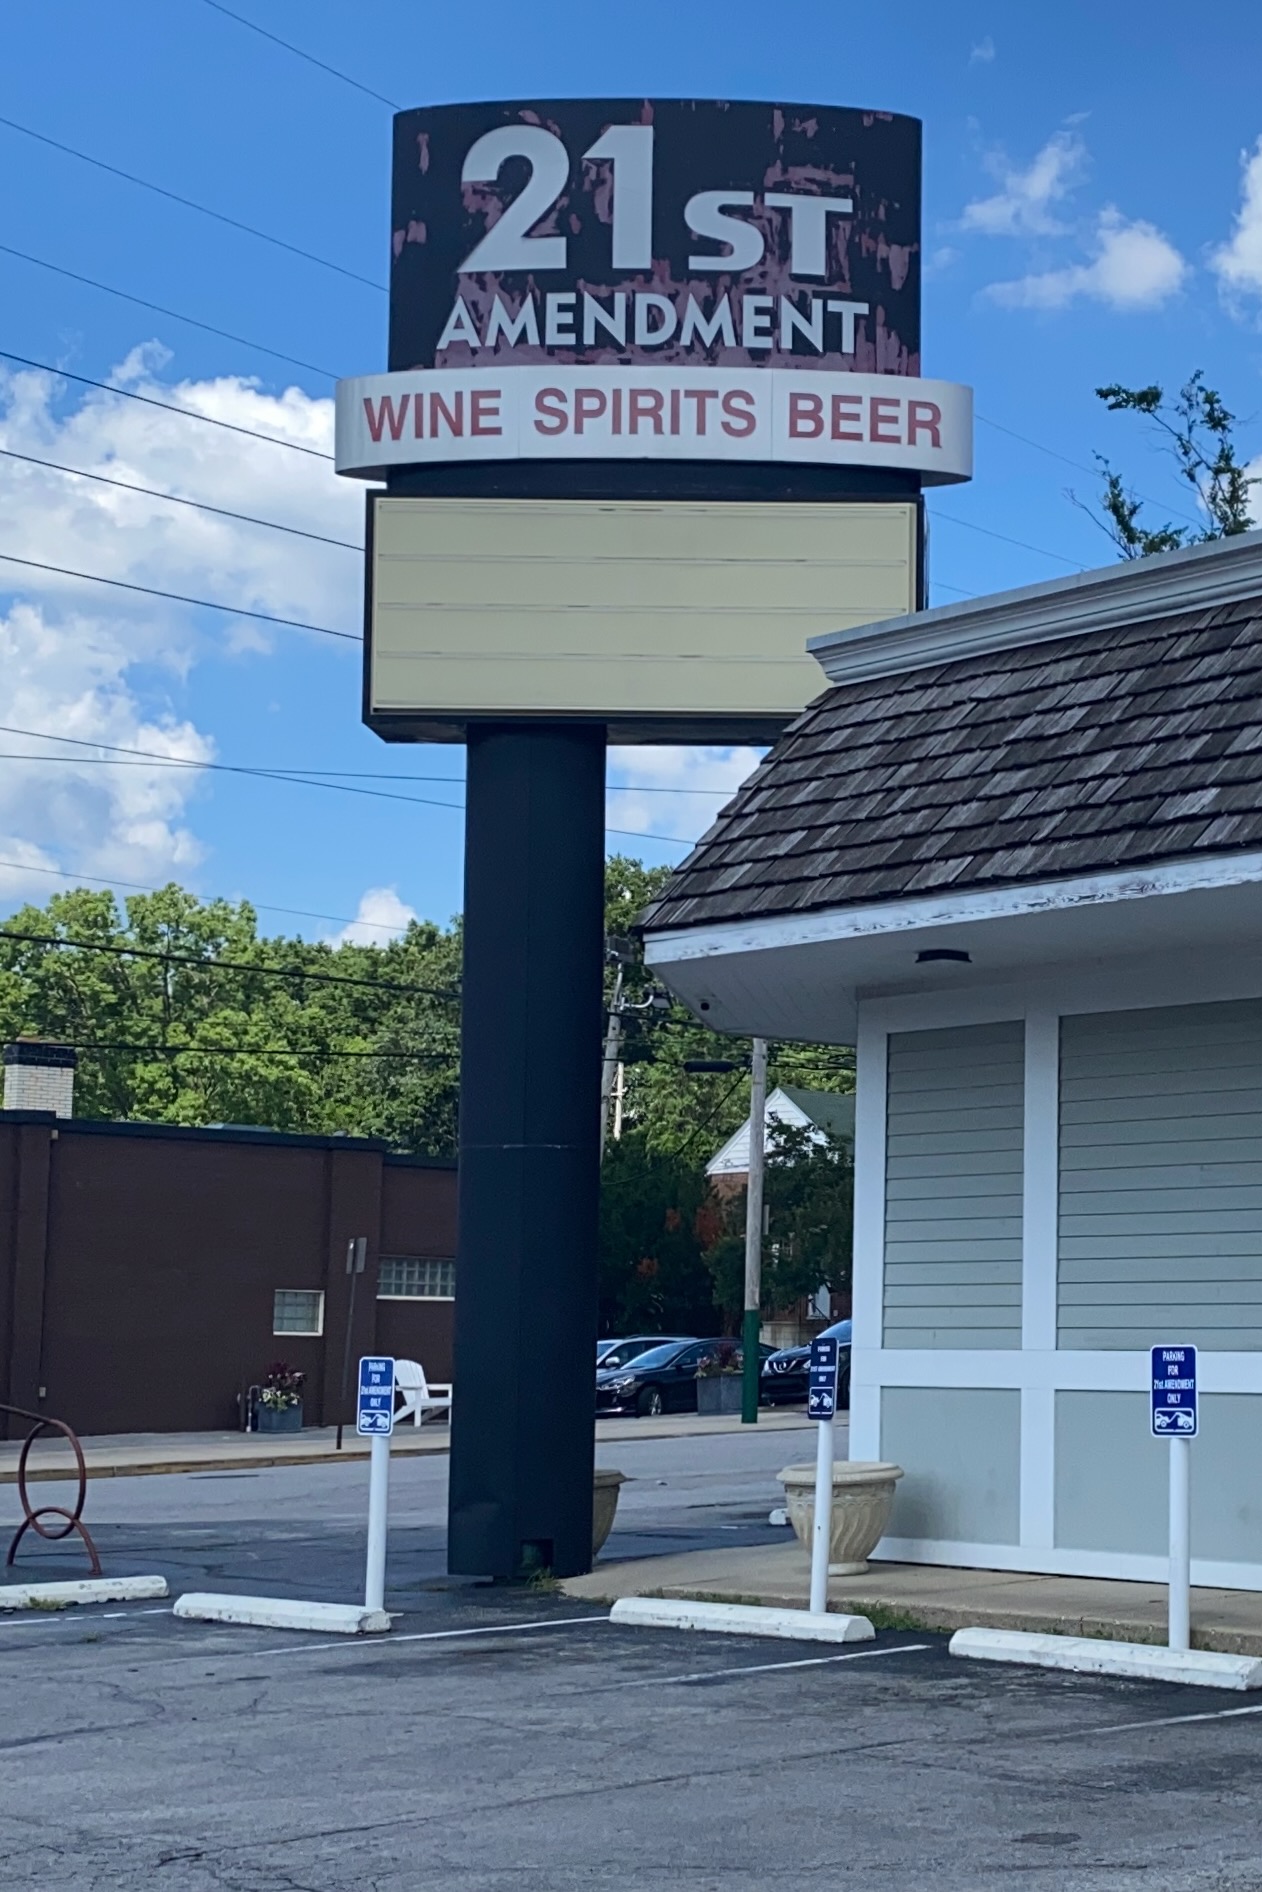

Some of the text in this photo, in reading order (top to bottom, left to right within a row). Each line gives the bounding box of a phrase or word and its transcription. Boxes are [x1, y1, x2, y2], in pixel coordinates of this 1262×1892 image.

[436, 291, 870, 355] AMENDMENT
[363, 387, 942, 448] WINE SPIRITS BEER
[1162, 1350, 1185, 1362] PARKING
[1167, 1365, 1179, 1376] FOR
[1167, 1393, 1181, 1404] ONLY
